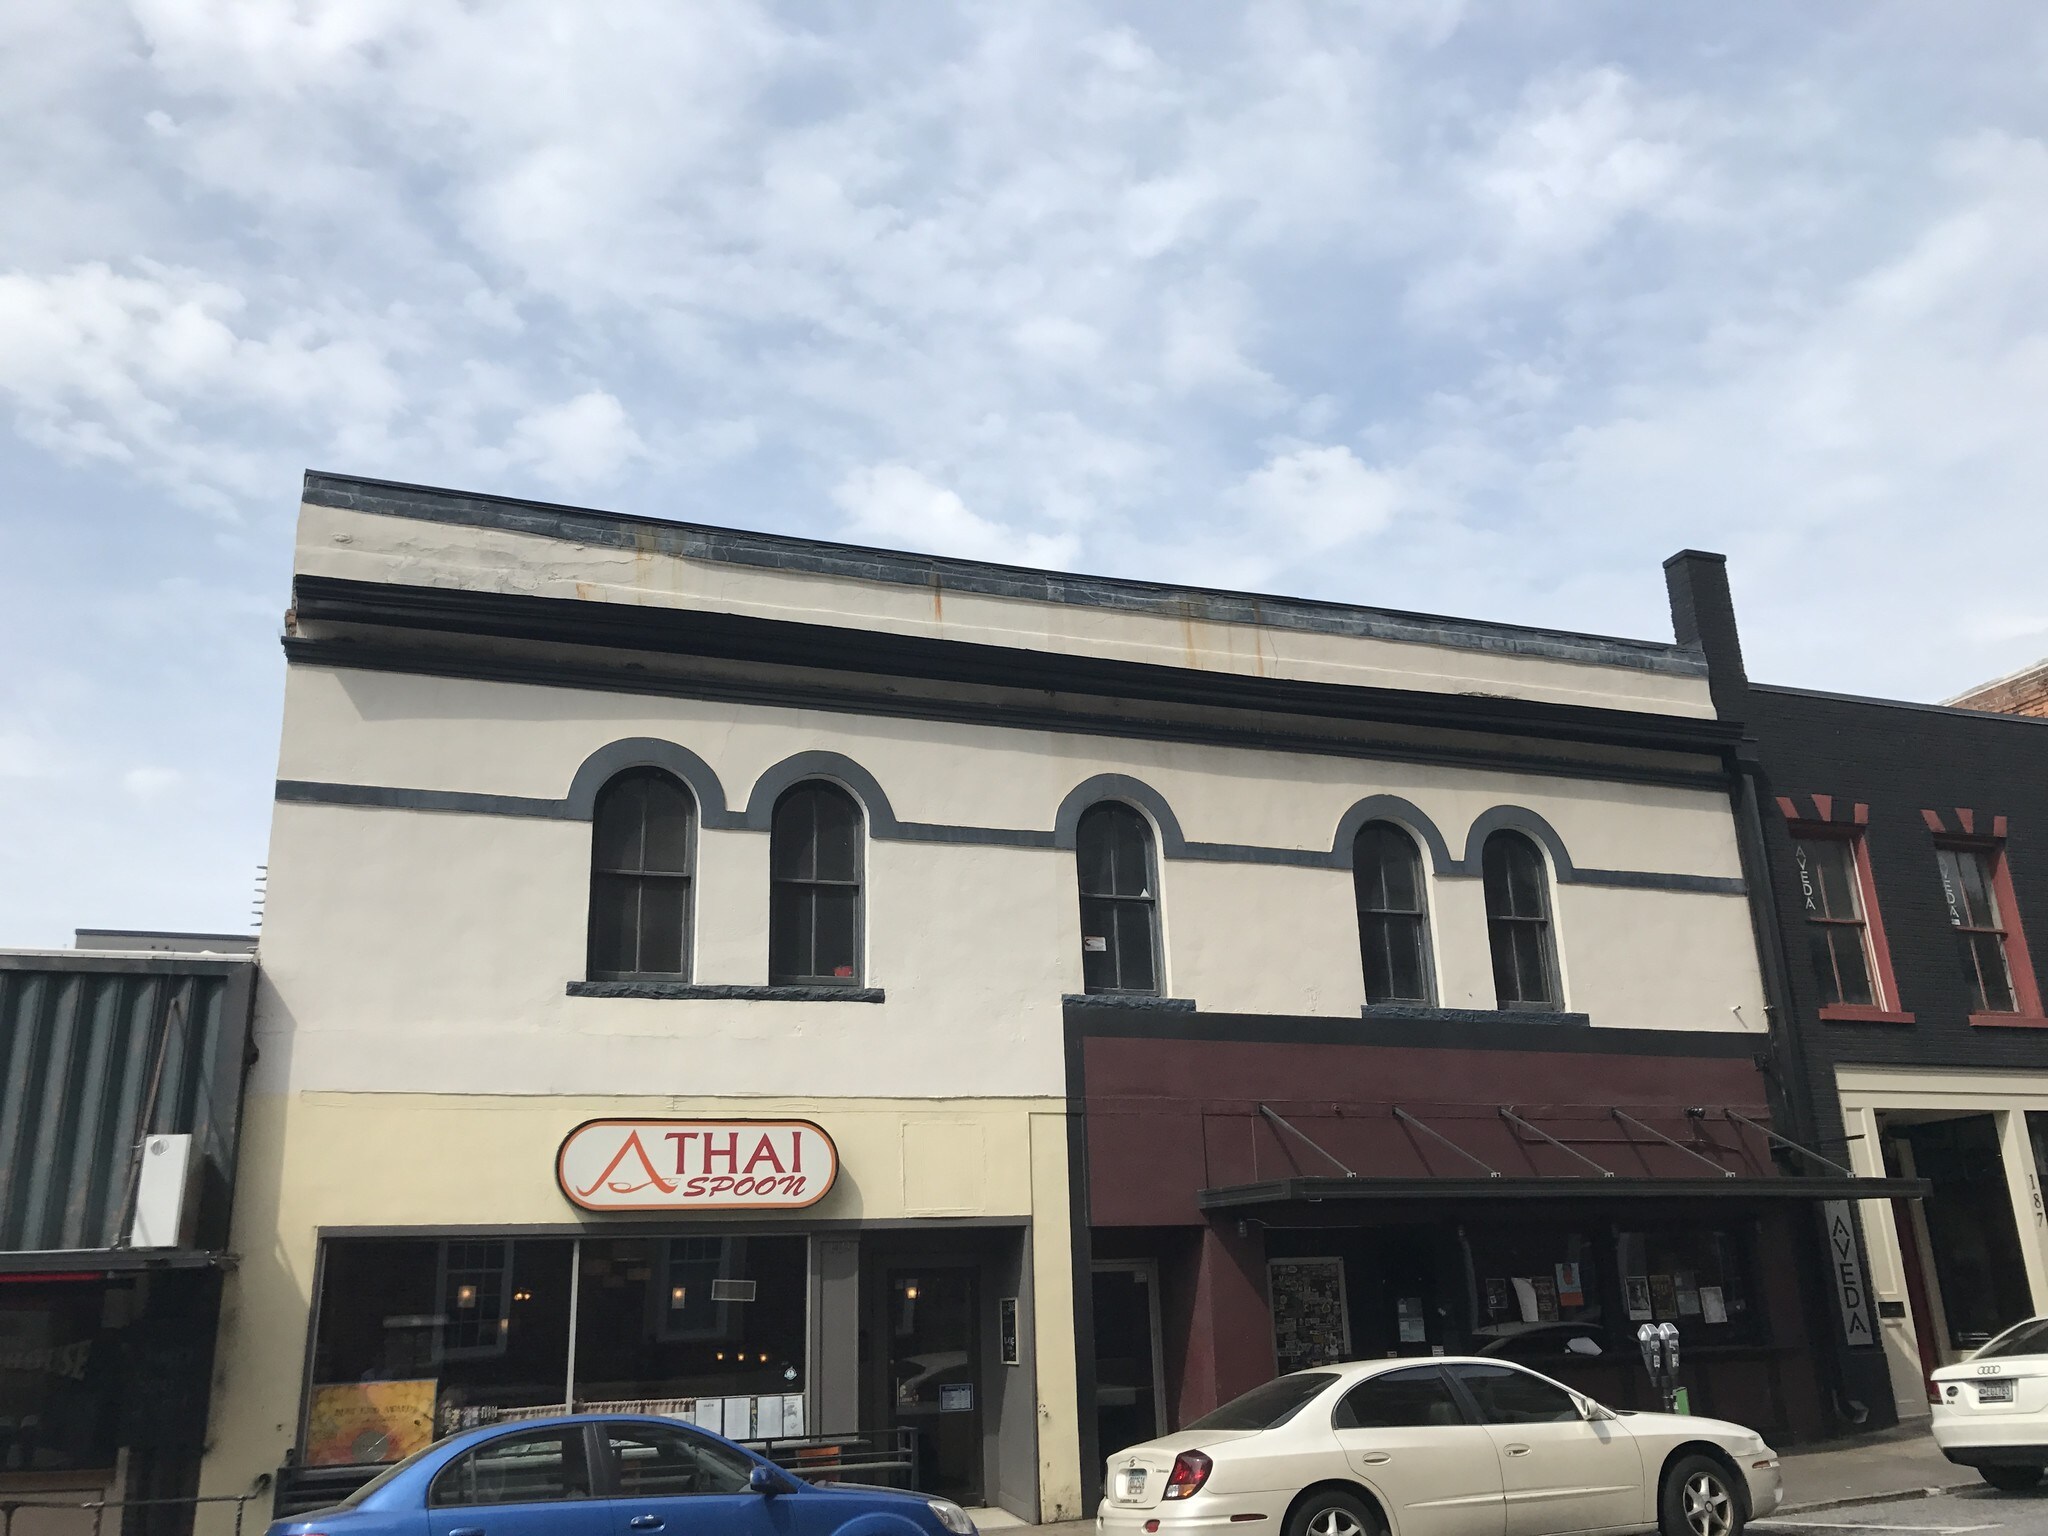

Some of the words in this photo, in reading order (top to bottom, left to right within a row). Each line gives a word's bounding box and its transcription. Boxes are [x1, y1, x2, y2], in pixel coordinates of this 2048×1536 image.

[1796, 846, 1816, 910] AVEDA
[664, 1131, 802, 1175] THAI
[682, 1175, 807, 1197] SPOON
[2029, 1173, 2044, 1228] 187
[1832, 1215, 1868, 1334] AVEDA
